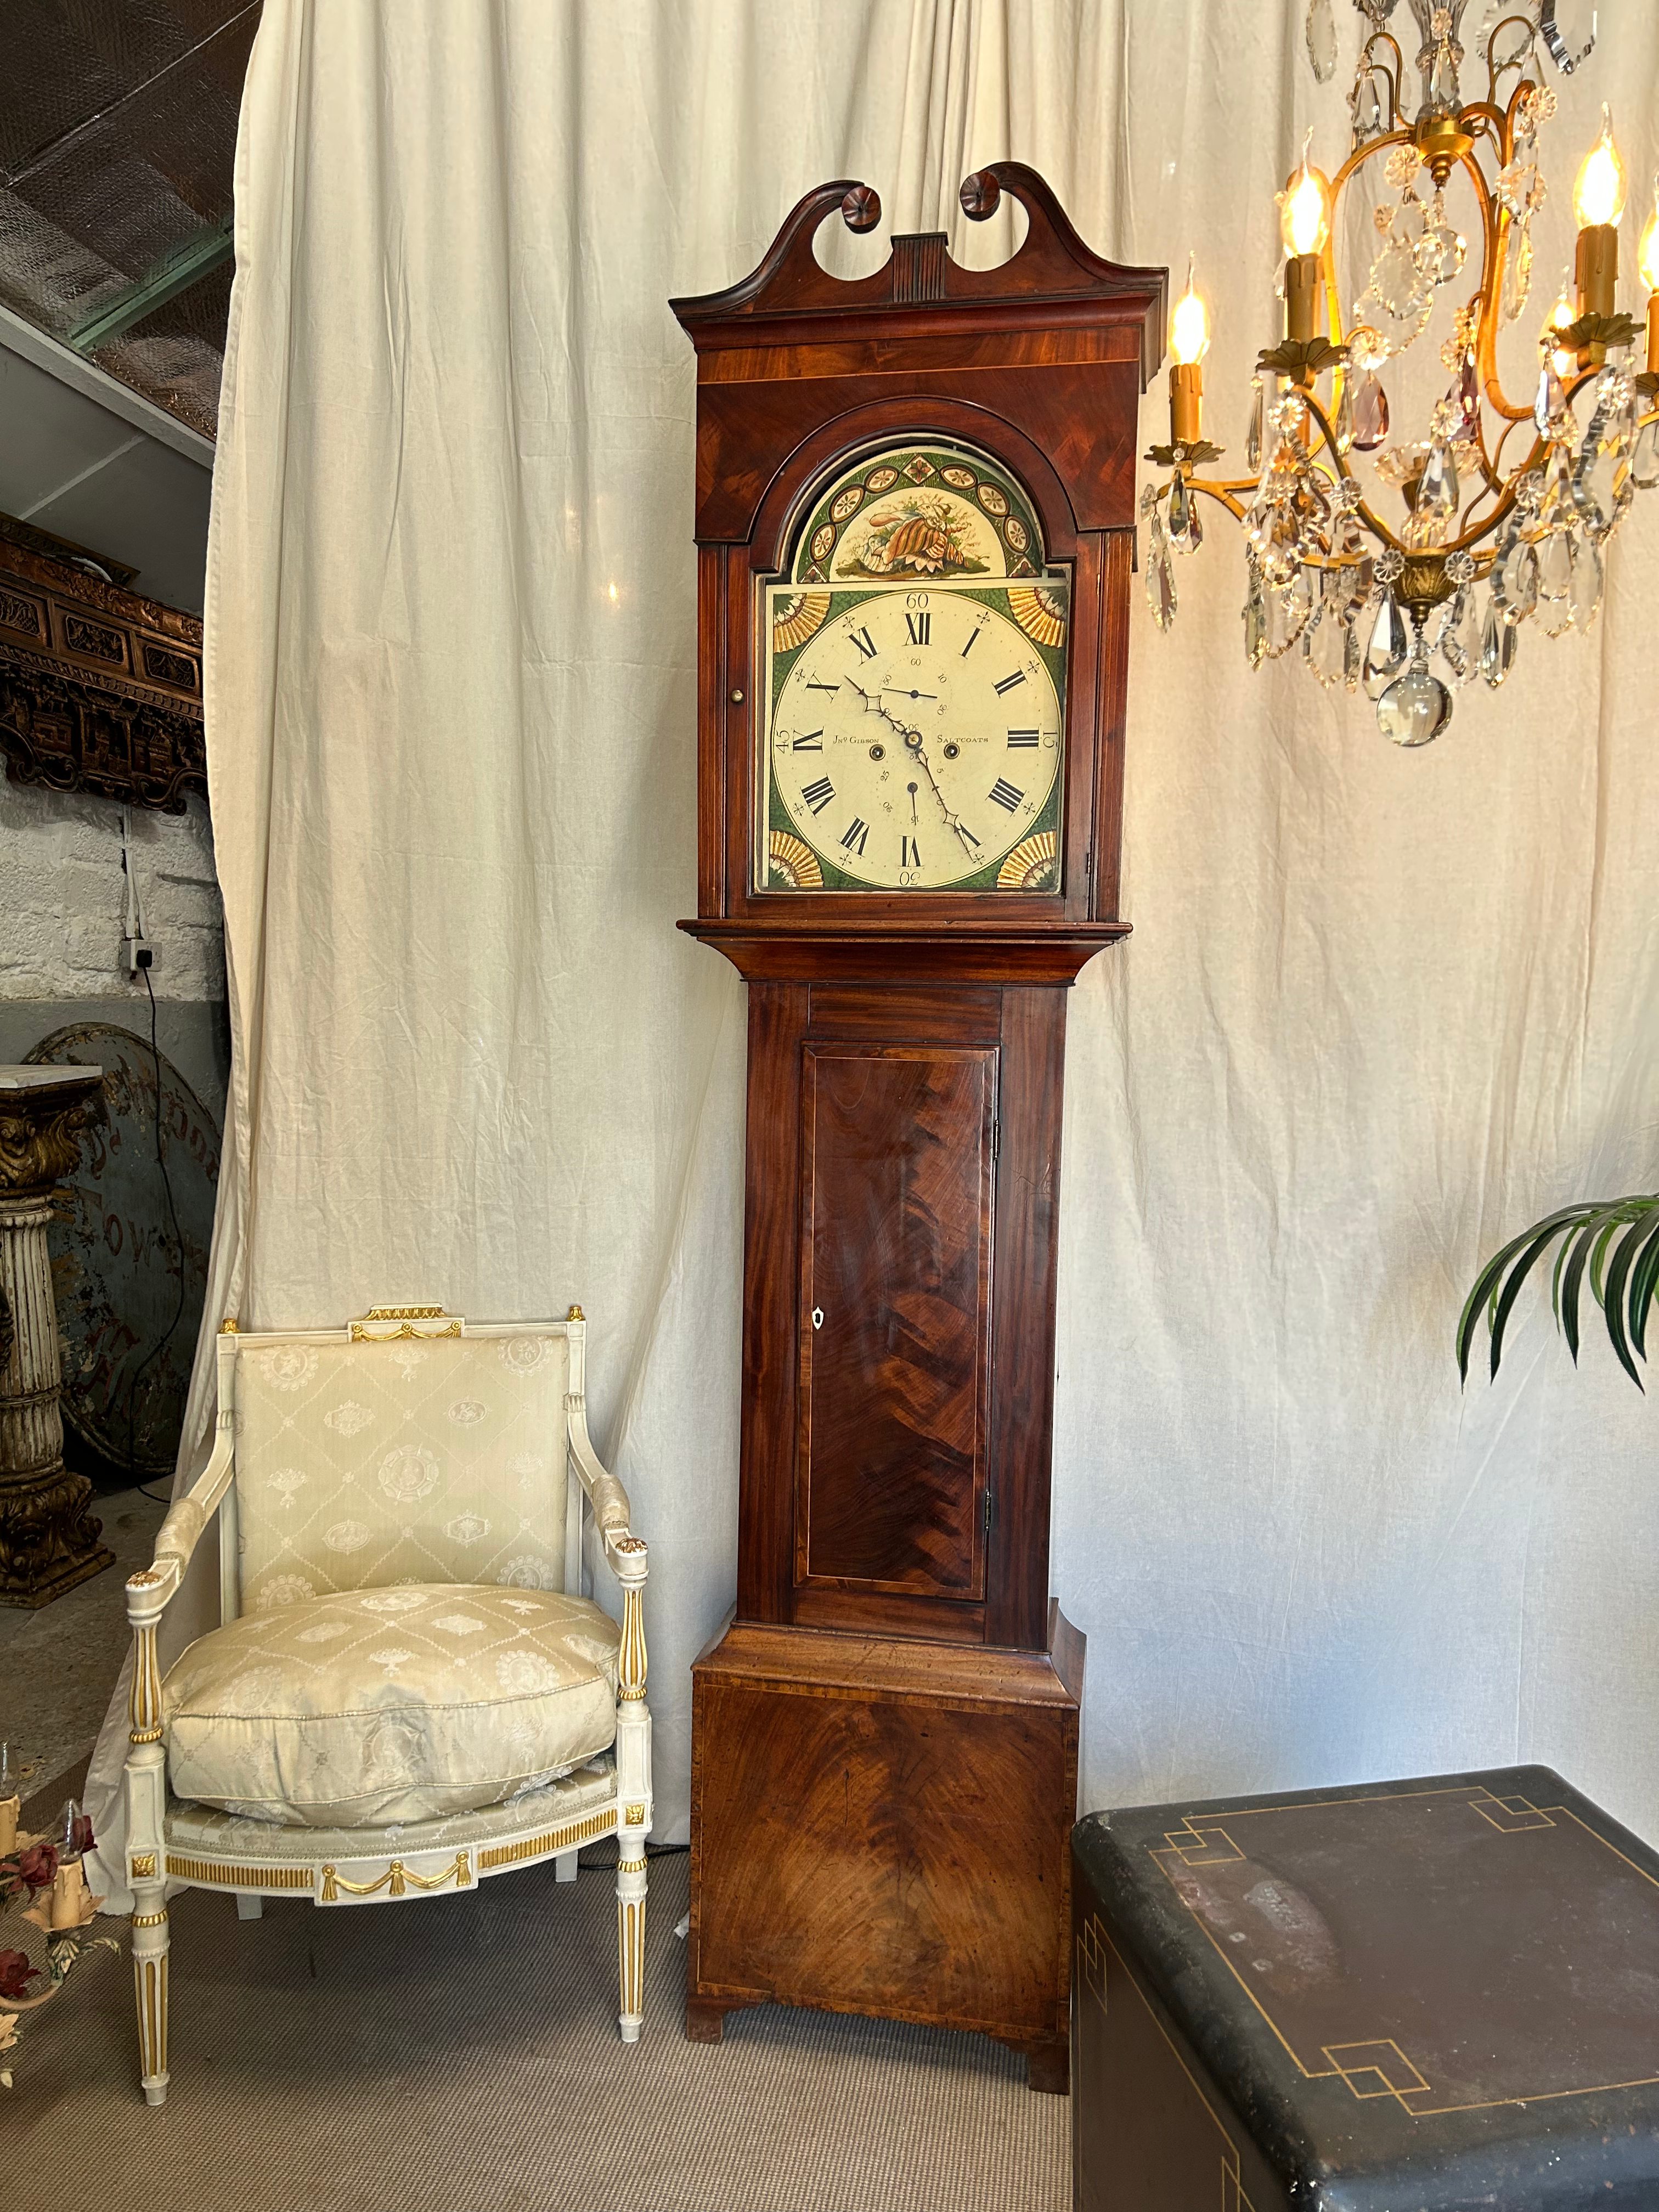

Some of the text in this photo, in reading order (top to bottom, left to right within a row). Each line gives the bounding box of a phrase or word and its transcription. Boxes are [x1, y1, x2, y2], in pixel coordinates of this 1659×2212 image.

[906, 593, 928, 609] 60
[901, 613, 933, 646] XII
[958, 625, 984, 659] I
[845, 624, 881, 667] XI
[804, 670, 842, 704] X
[882, 674, 892, 686] 50
[938, 673, 947, 684] 10
[991, 665, 1029, 698] II
[776, 730, 790, 754] 45
[793, 726, 824, 754] IX
[937, 734, 989, 743] SALTCOATS
[1007, 726, 1040, 752] III
[799, 772, 837, 819] VIII
[836, 815, 870, 857] VII
[898, 834, 925, 867] VI
[899, 871, 921, 886] 30
